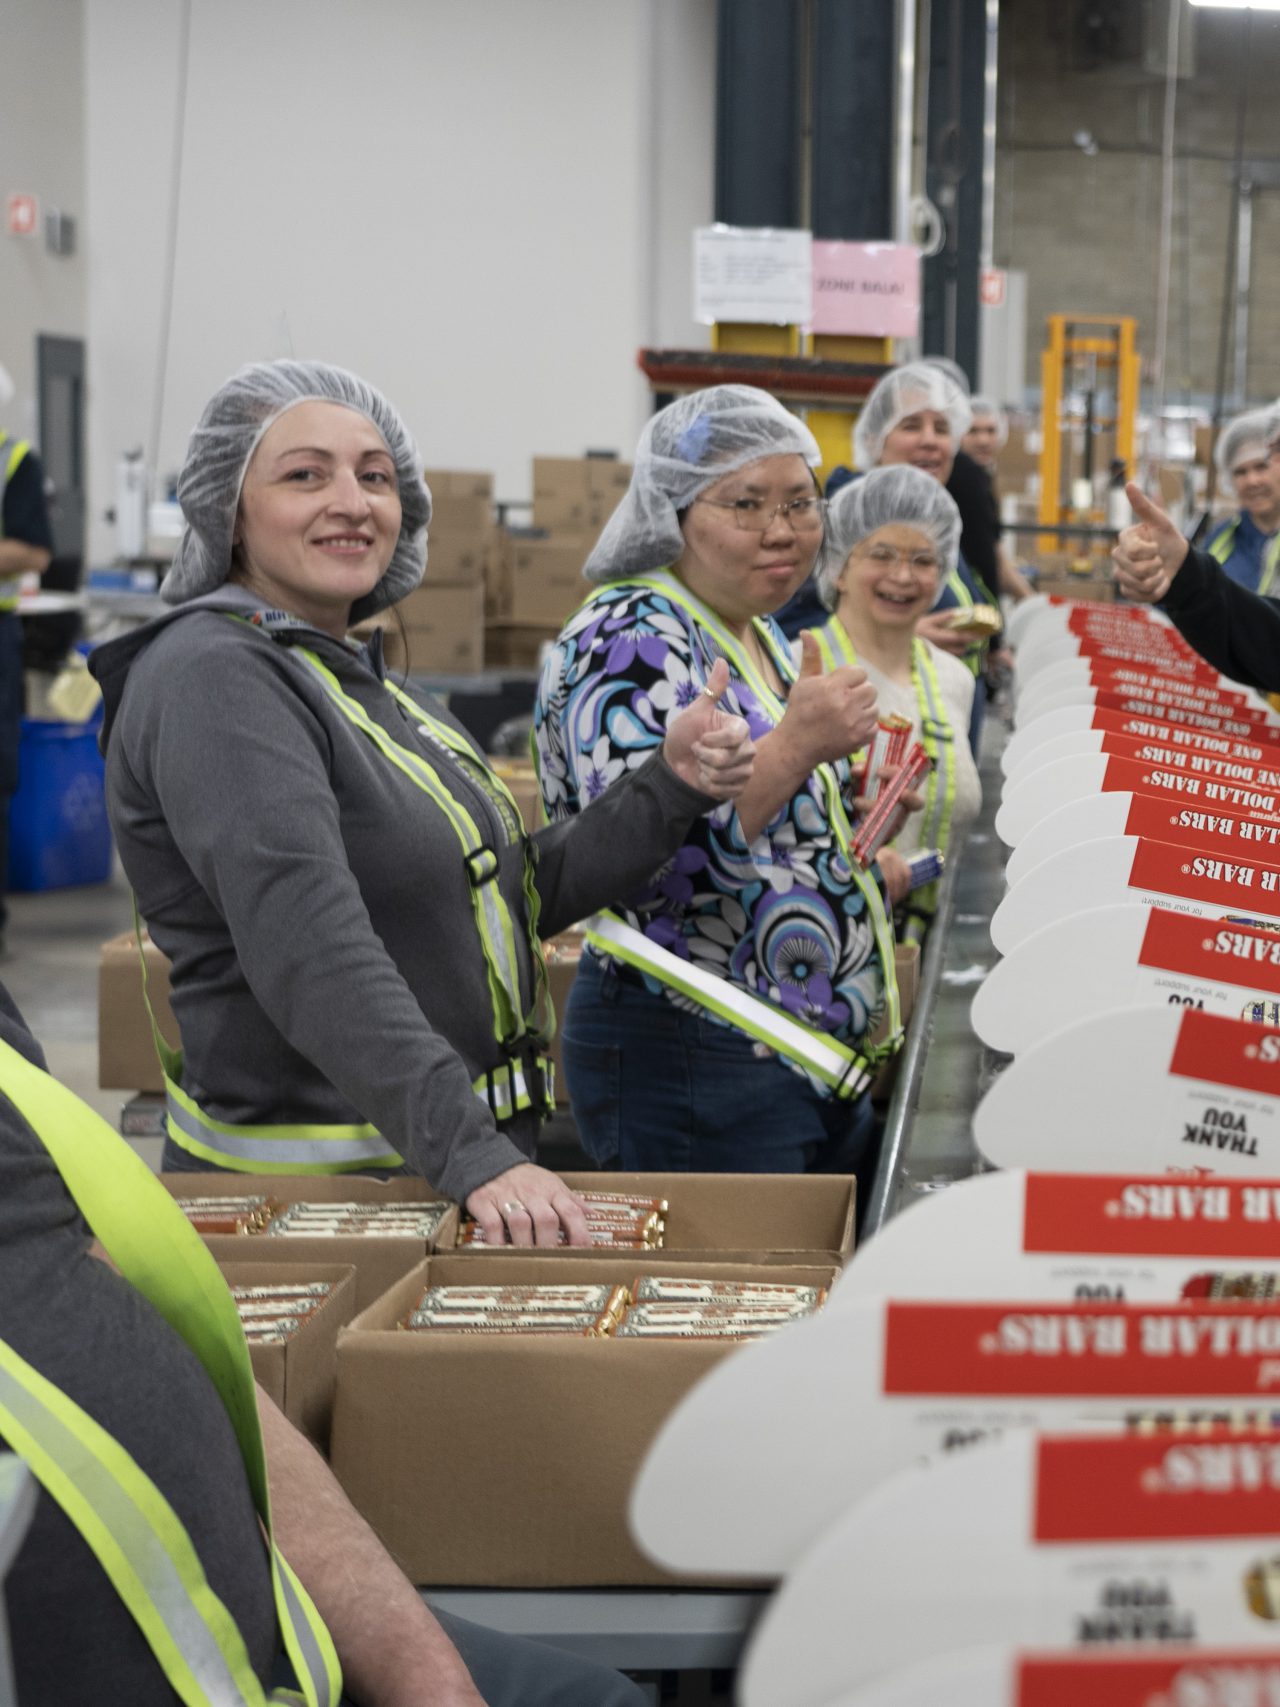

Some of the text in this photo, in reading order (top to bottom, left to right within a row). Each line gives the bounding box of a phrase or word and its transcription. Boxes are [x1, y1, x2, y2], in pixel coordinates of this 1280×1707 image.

[1173, 730, 1231, 755] DOLLAR
[1234, 743, 1262, 762] ONE
[1191, 755, 1254, 781] DOLLAR
[1205, 782, 1275, 811] DOLLAR
[1173, 903, 1190, 912] your
[1202, 1108, 1246, 1133] YOU
[1182, 1122, 1258, 1156] THANK
